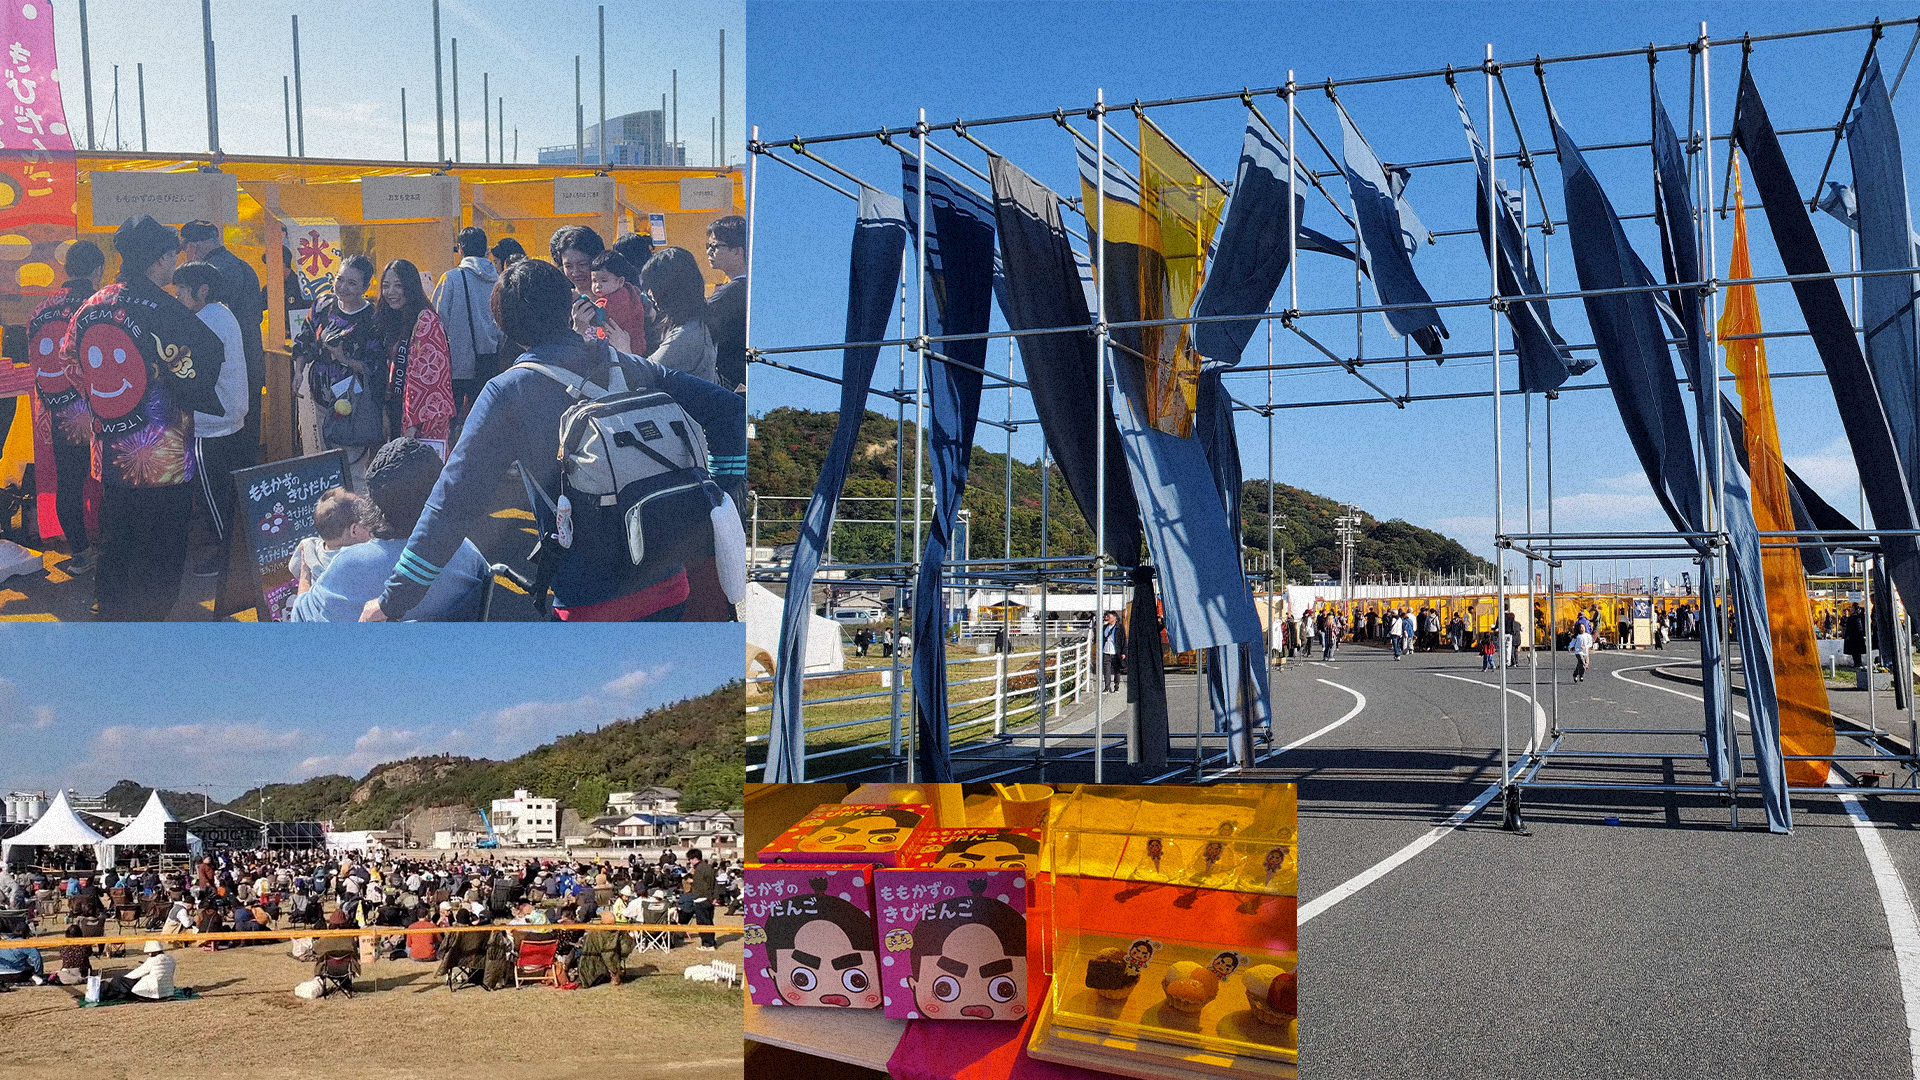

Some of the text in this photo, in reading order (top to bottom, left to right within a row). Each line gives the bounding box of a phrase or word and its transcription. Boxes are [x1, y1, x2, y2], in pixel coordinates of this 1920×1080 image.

[297, 229, 333, 277] 氷
[394, 369, 404, 395] ONE
[248, 472, 300, 501] ももかずの
[286, 470, 341, 503] きびだんご
[286, 502, 315, 521] きびだん
[922, 834, 1000, 843] きびだんご
[930, 828, 987, 837] ももかずの
[880, 881, 955, 901] ももかずの
[883, 899, 974, 923] きびだんご
